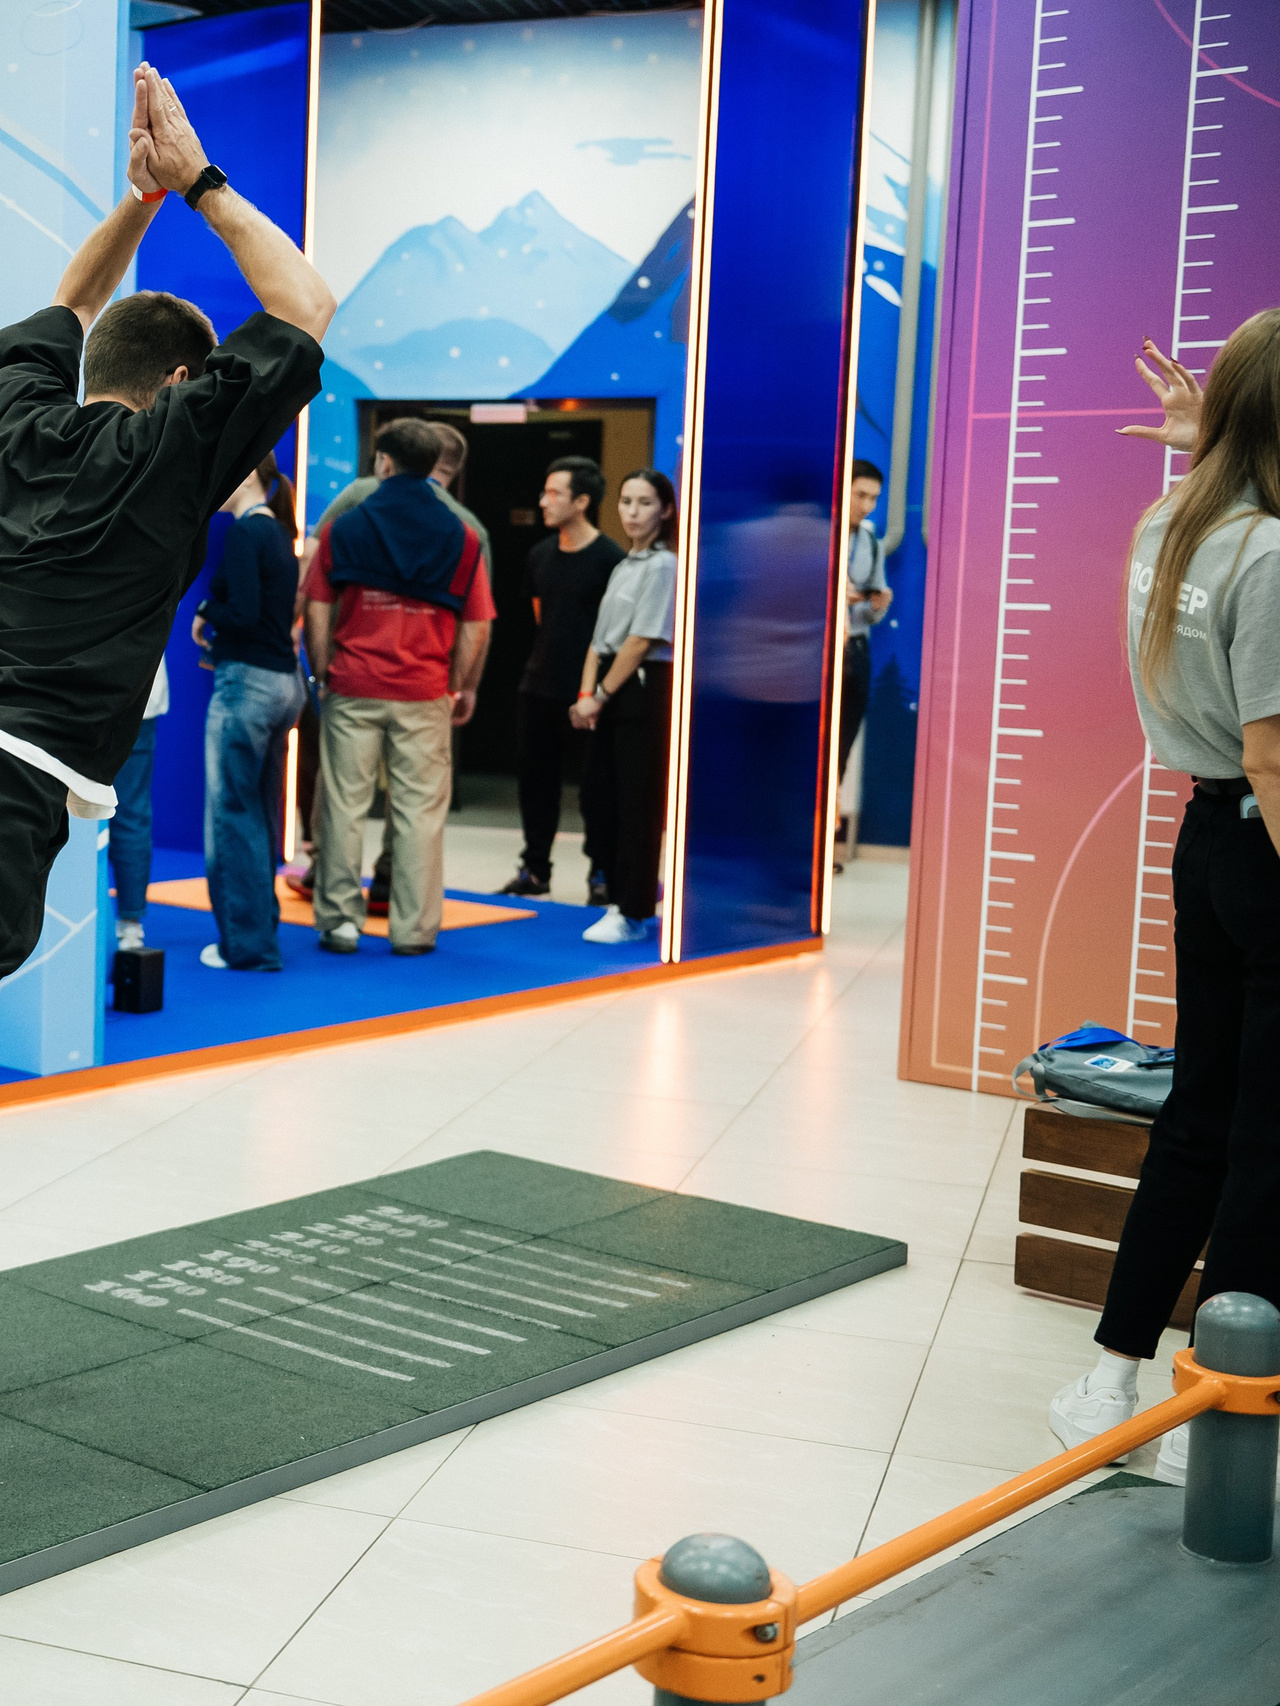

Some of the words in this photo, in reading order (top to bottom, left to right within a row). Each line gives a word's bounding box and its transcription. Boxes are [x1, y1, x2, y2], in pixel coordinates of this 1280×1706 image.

[1175, 624, 1207, 641] ядом
[270, 1231, 351, 1255] 210
[161, 1260, 245, 1286] 180
[199, 1250, 280, 1275] 190
[83, 1280, 170, 1308] 160
[123, 1270, 208, 1296] 170
